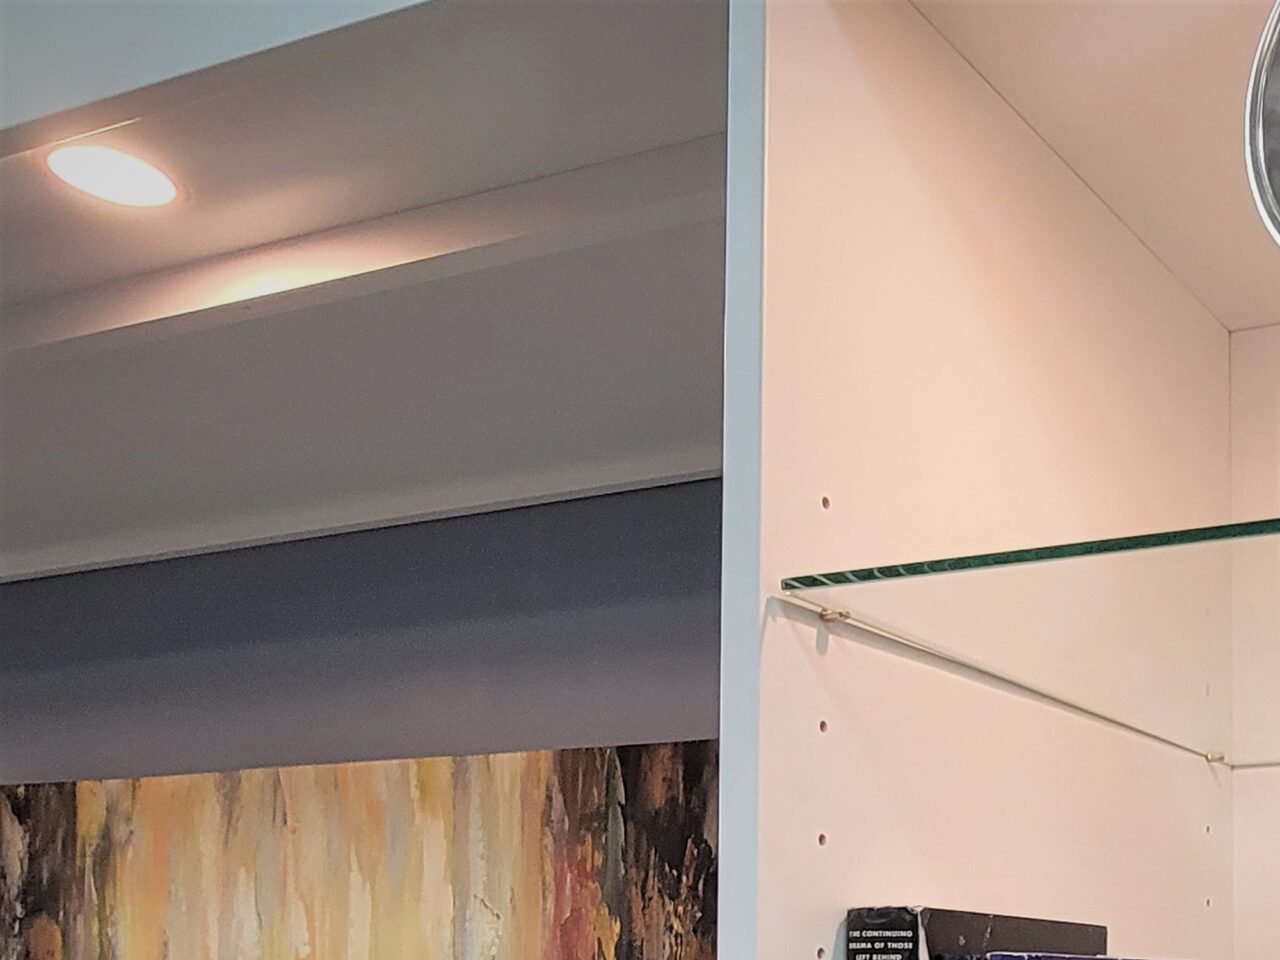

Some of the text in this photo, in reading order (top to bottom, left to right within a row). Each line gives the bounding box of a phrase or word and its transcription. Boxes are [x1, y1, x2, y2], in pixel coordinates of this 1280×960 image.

[861, 930, 913, 938] CONTINUING
[855, 953, 903, 960] LEFT BEHIND
